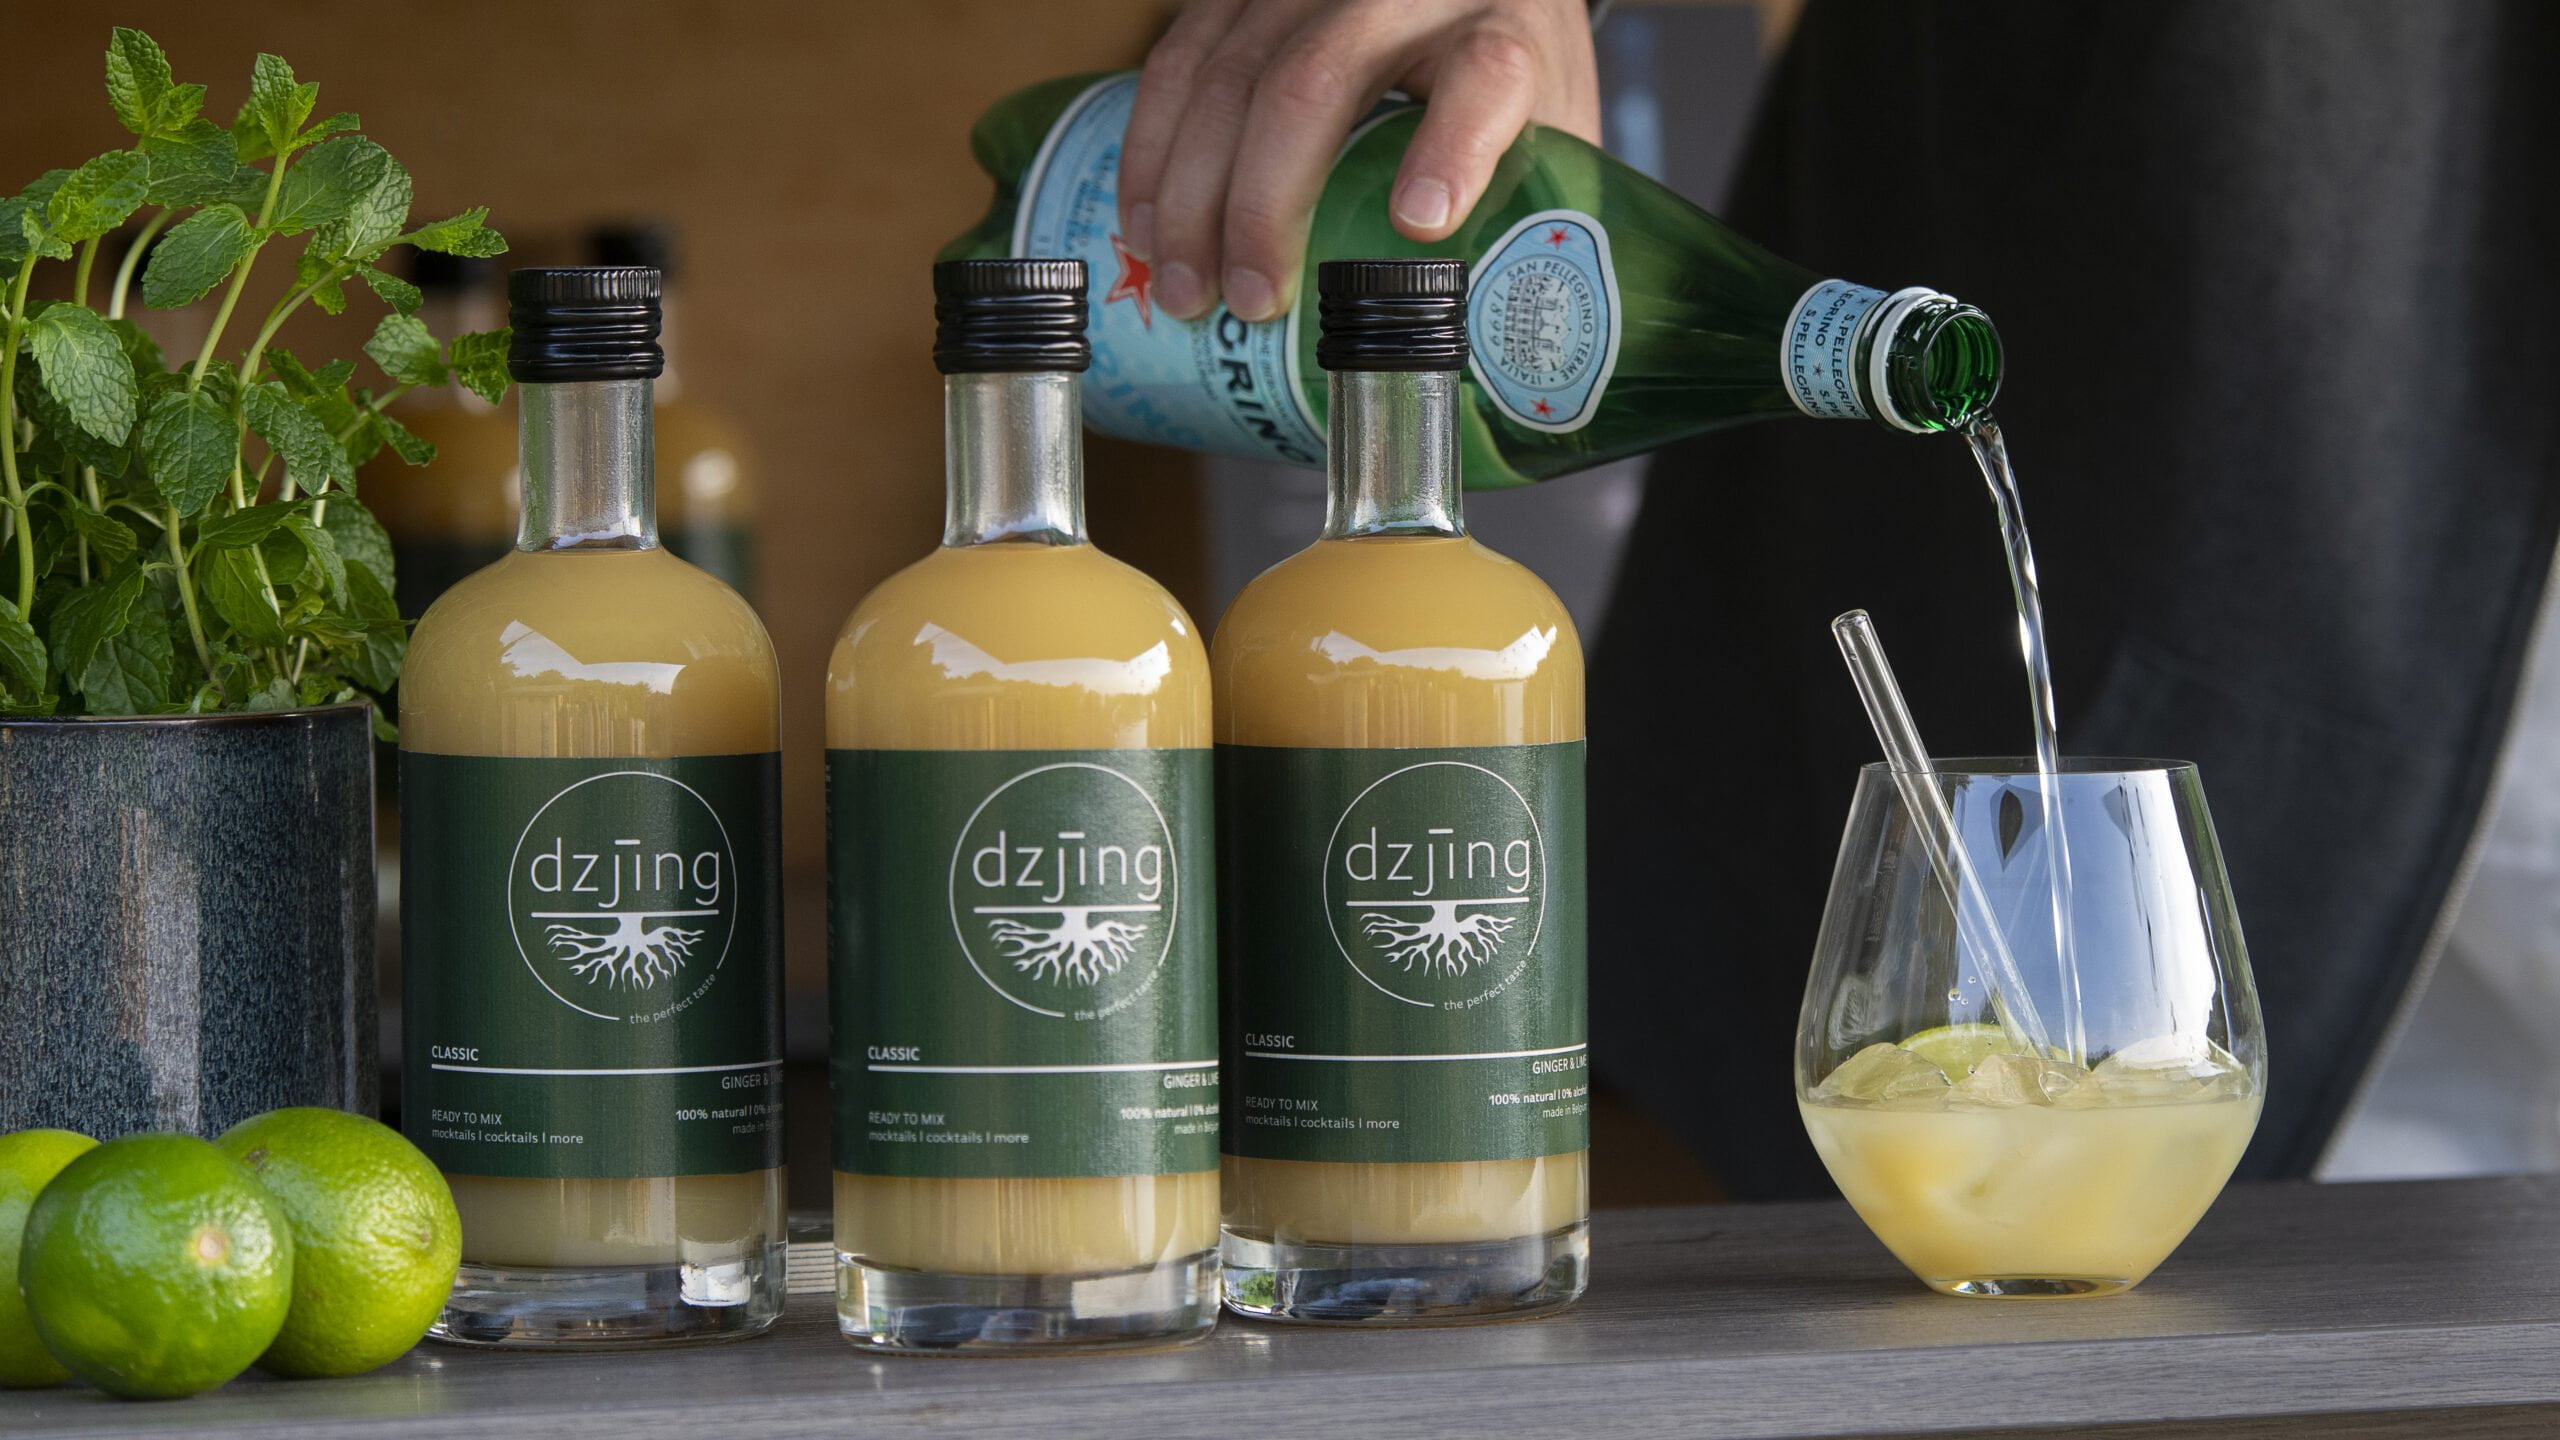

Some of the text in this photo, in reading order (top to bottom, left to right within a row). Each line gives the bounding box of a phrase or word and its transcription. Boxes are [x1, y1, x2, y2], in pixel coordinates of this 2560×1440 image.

[1500, 261, 1593, 386] SAN PELLEGRINO TERME ITALIA
[1444, 960, 1527, 1010] the perfect taste
[630, 974, 717, 1025] the perfect taste
[1074, 1009, 1096, 1022] the
[1245, 1033, 1295, 1048] CLASSIC
[431, 1045, 479, 1061] CLASSIC
[867, 1046, 920, 1061] CLASSIC
[1532, 1058, 1569, 1074] GINGER
[1569, 1057, 1576, 1070] &
[721, 1073, 760, 1090] GINGER
[1163, 1072, 1201, 1089] GINGER
[1245, 1096, 1319, 1112] READY TO MIX
[1488, 1093, 1520, 1106] 100%
[1523, 1090, 1556, 1103] natural
[1561, 1088, 1573, 1099] 0%
[431, 1109, 503, 1125] READY TO MIX
[675, 1108, 709, 1120] 100%
[711, 1105, 747, 1119] natural
[754, 1104, 766, 1116] 0%
[868, 1111, 945, 1126] READY TO MIX
[1120, 1107, 1153, 1120] 100%
[1154, 1104, 1188, 1119] natural
[1542, 1105, 1564, 1119] made
[1564, 1104, 1571, 1115] in
[1245, 1114, 1291, 1127] mocktails
[1301, 1117, 1355, 1129] cocktails
[1366, 1119, 1400, 1129] more
[431, 1127, 476, 1141] mocktails
[484, 1131, 538, 1144] cocktails
[550, 1134, 584, 1144] more
[868, 1130, 917, 1142] mocktails
[926, 1131, 982, 1144] cocktails
[993, 1133, 1029, 1144] more
